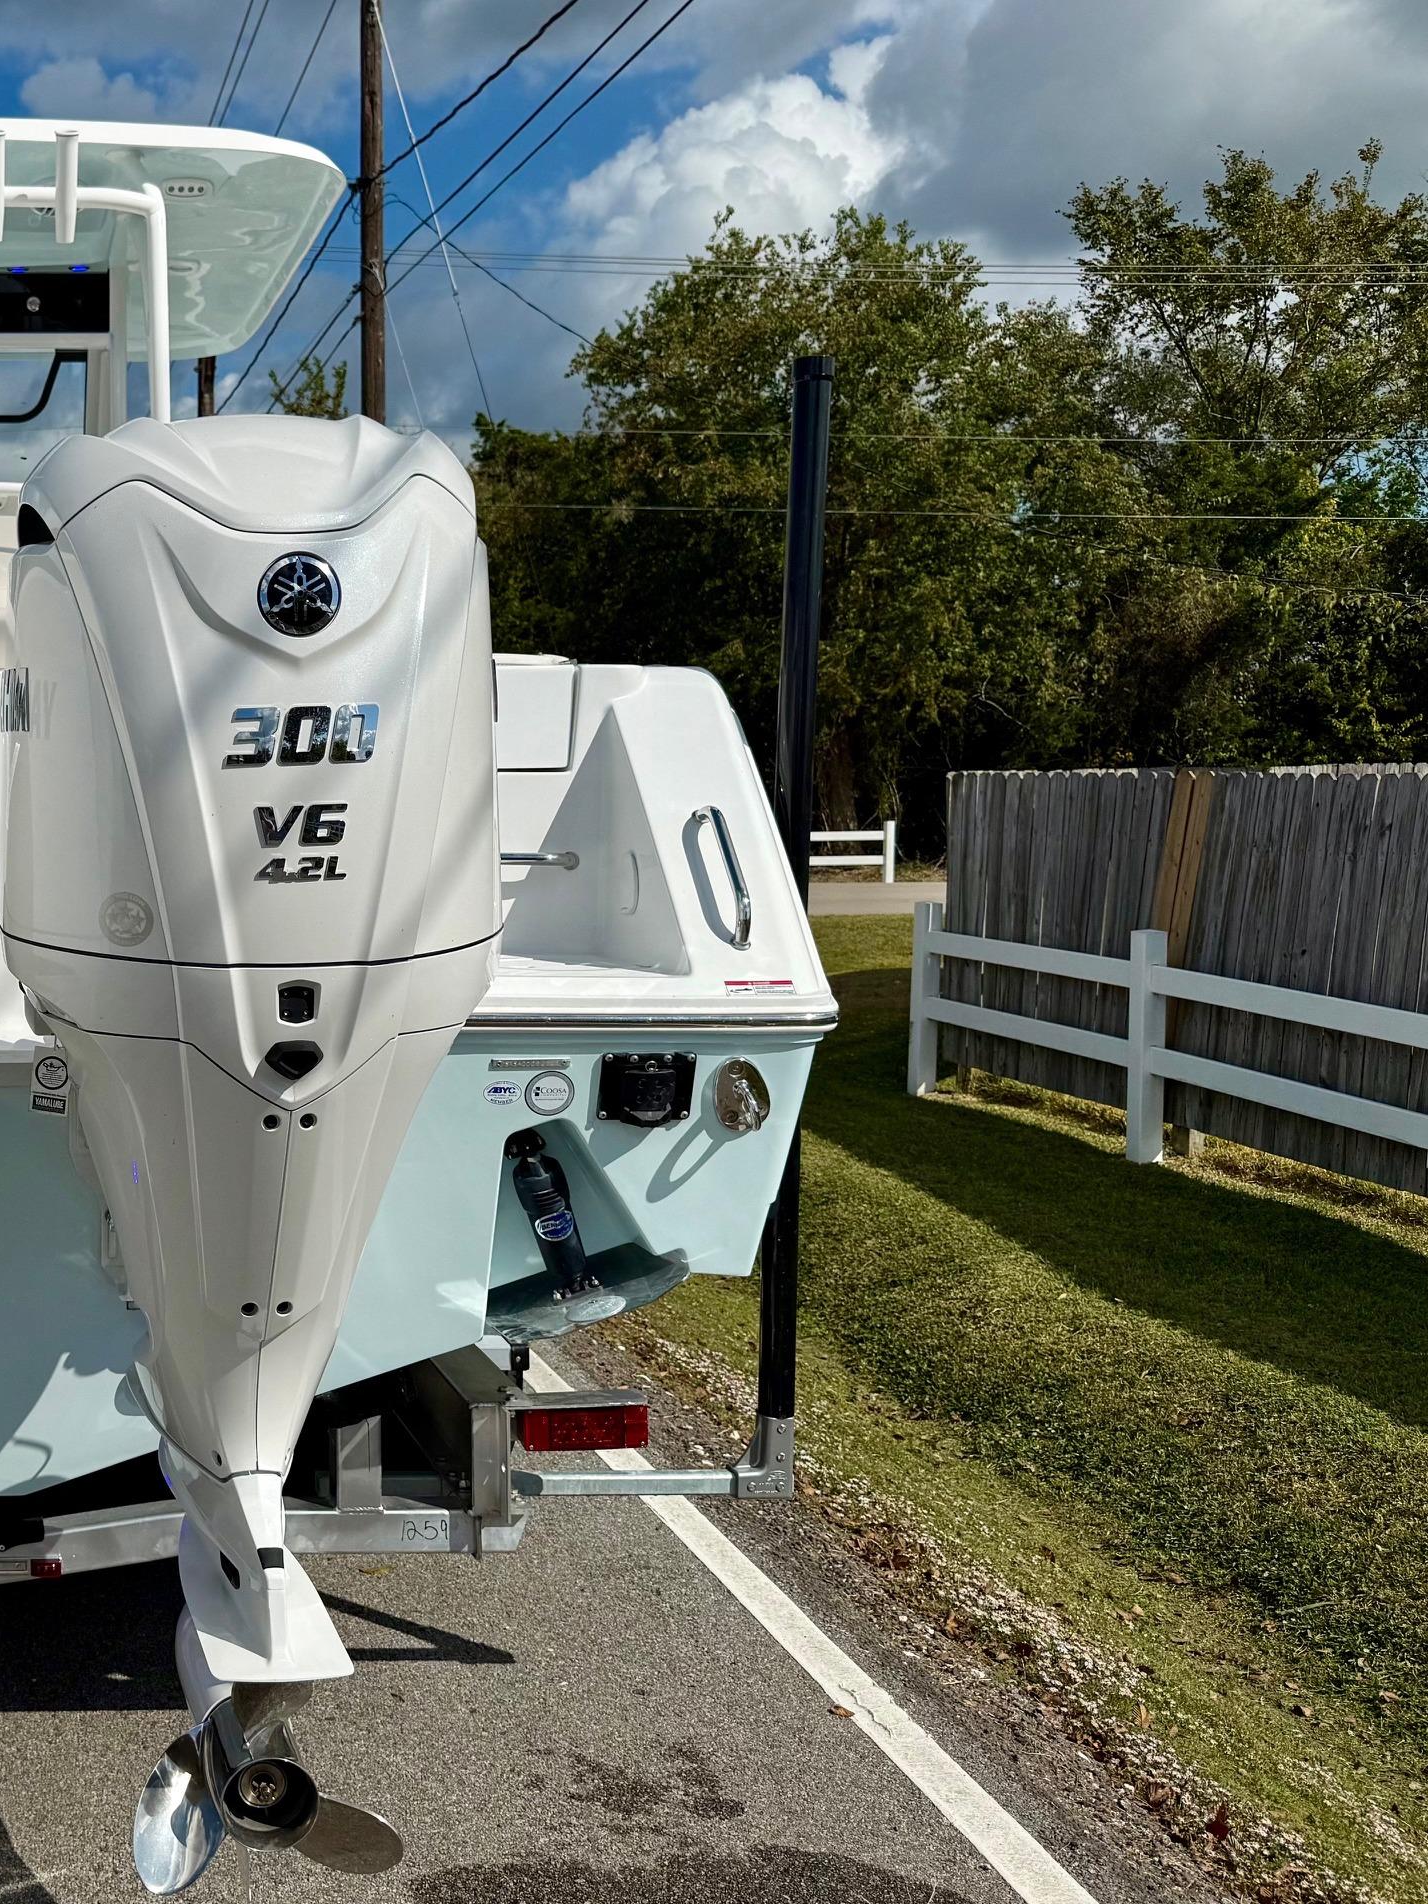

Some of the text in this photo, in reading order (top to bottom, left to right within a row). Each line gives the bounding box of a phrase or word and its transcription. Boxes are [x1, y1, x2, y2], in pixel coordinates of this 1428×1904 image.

[221, 703, 380, 770] 300
[253, 803, 348, 849] V6
[253, 855, 347, 884] 4.2L
[35, 1096, 65, 1109] YAMALUBE
[487, 1086, 516, 1094] ABYC
